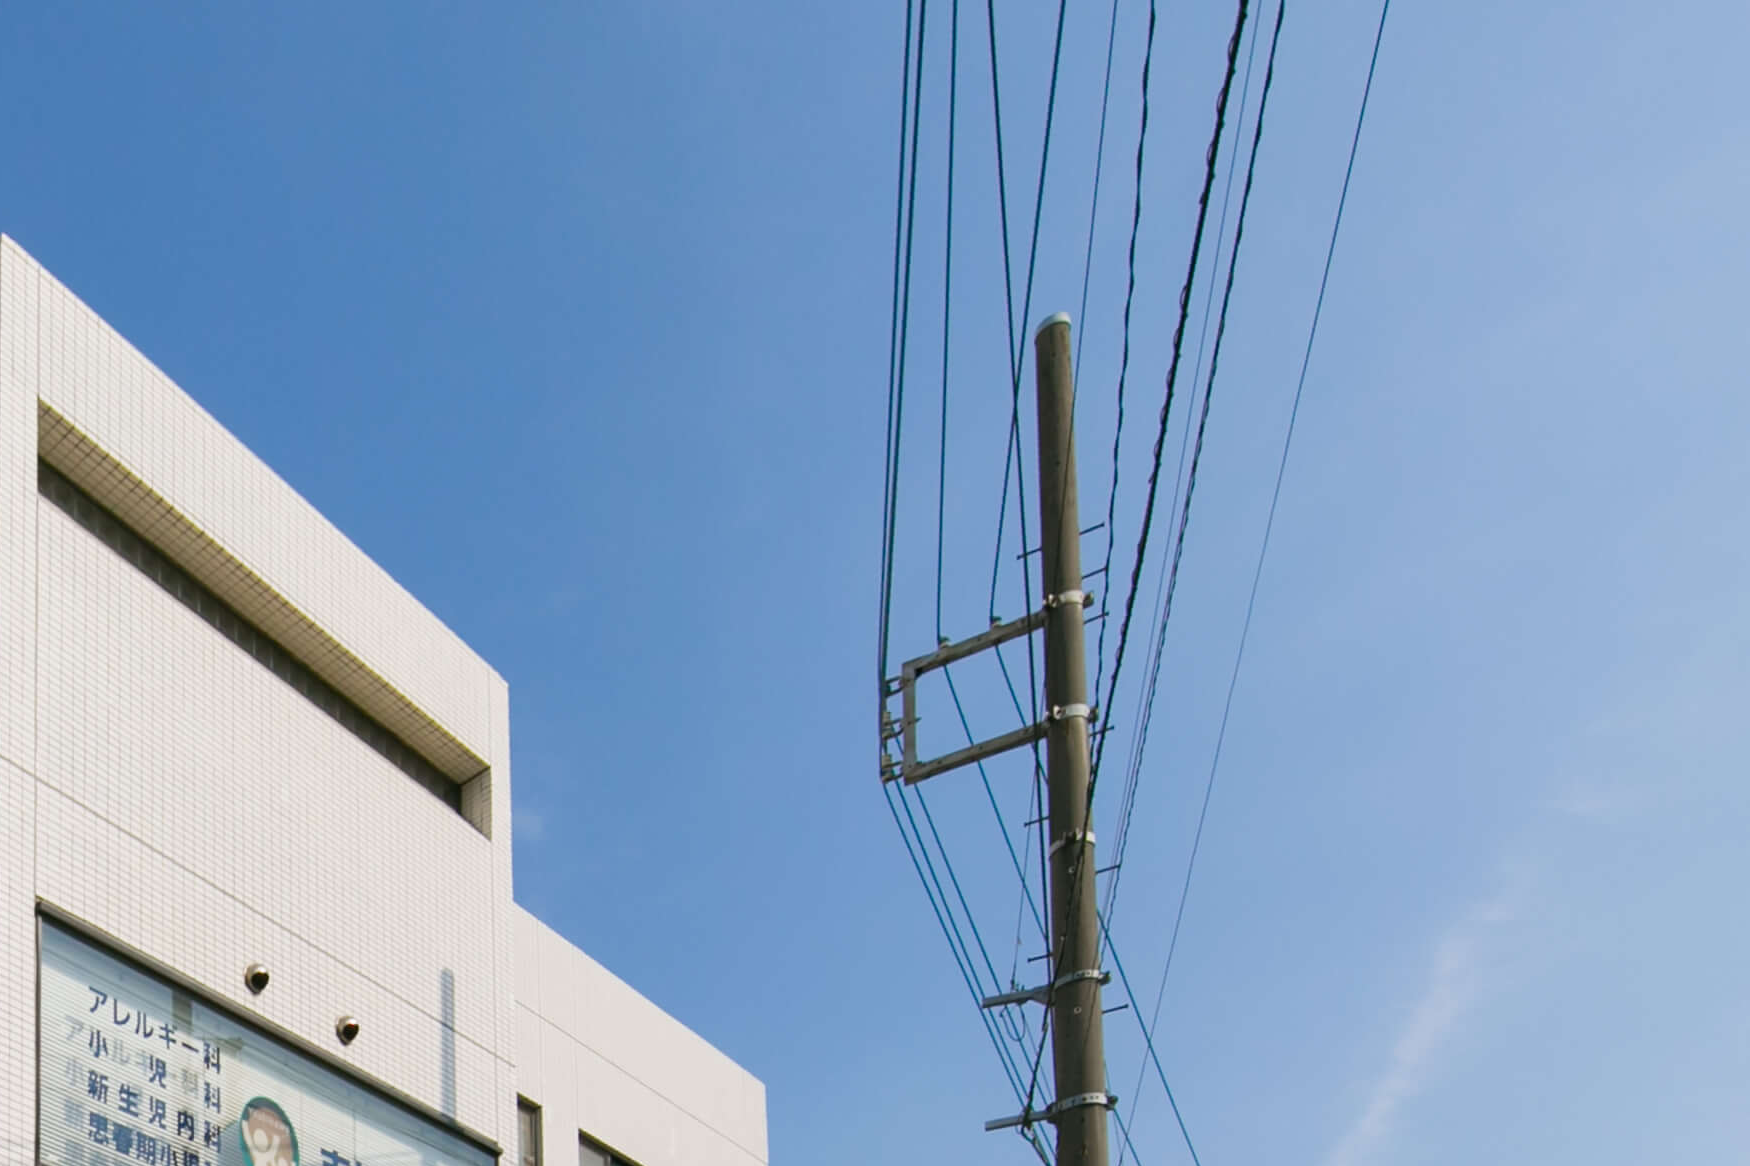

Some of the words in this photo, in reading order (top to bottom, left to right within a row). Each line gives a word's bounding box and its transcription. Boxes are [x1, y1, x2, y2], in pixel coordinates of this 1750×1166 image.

[88, 986, 220, 1075] アレルギー科
[88, 1030, 221, 1114] 小児科
[88, 1069, 221, 1153] 新生児内科
